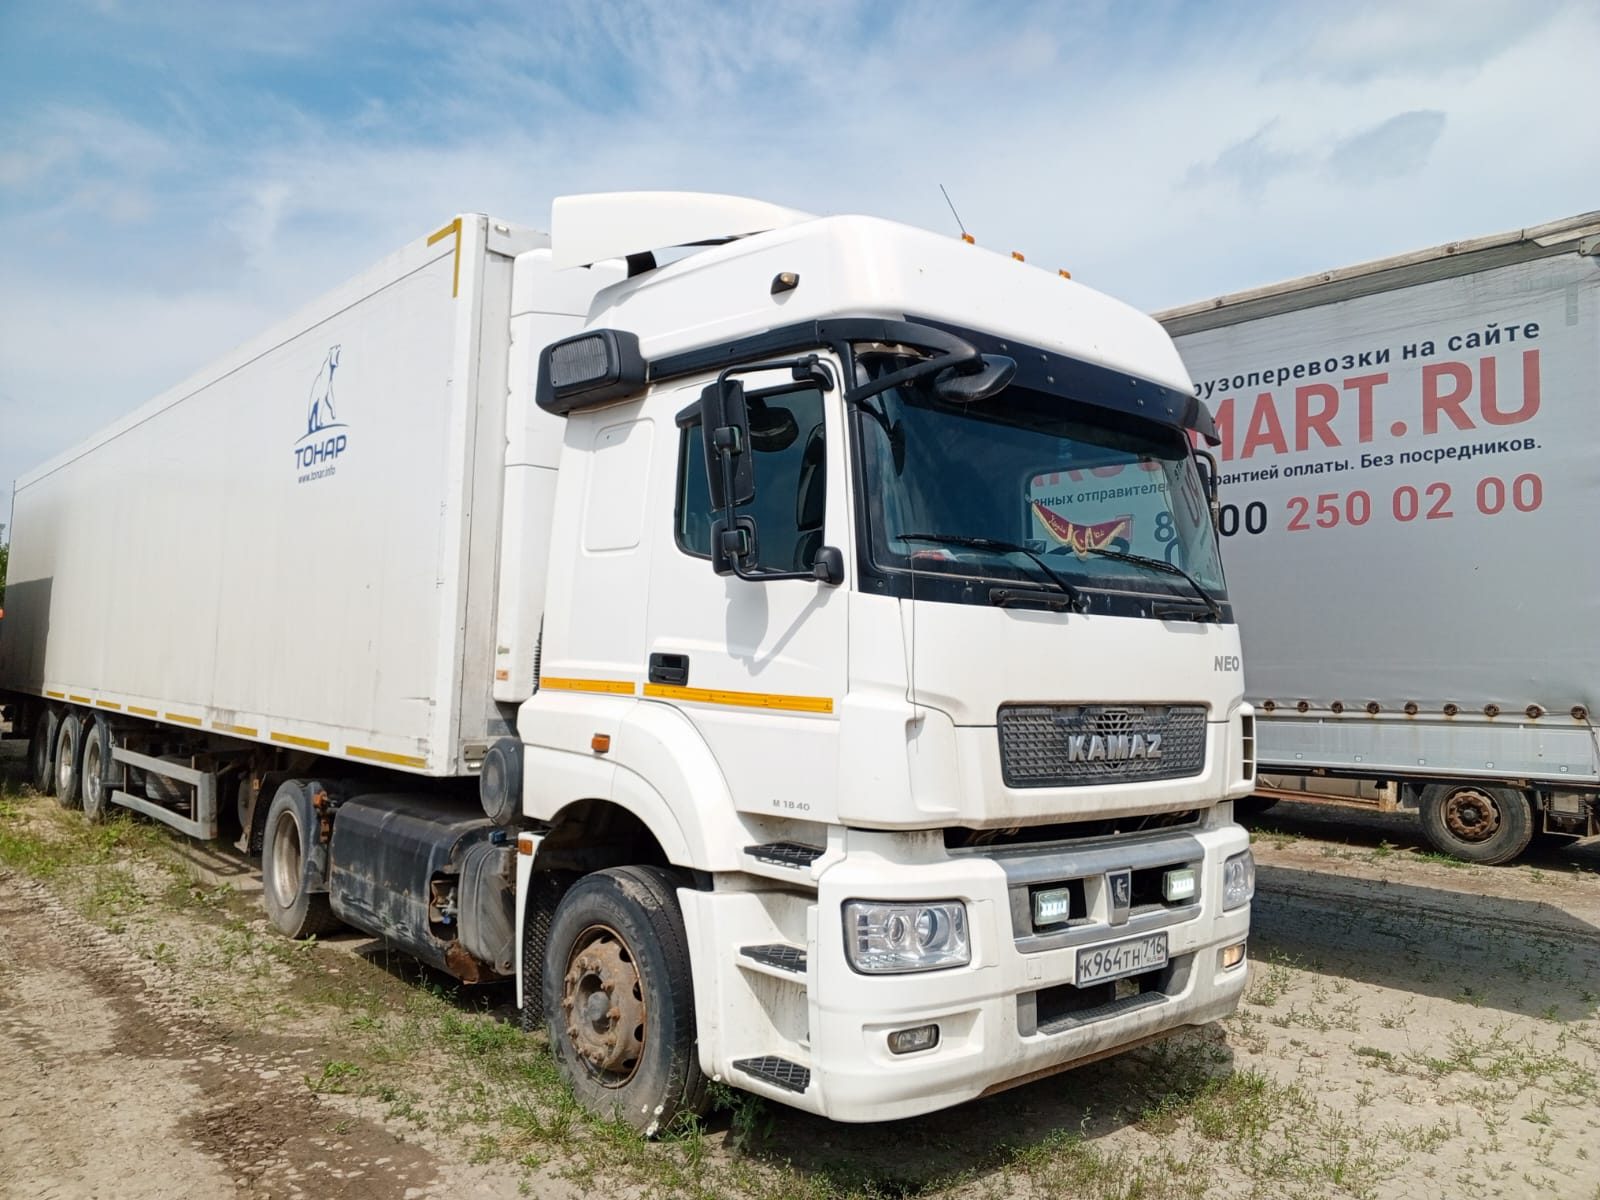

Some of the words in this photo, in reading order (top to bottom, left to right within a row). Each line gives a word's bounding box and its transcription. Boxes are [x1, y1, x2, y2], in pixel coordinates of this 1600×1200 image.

[1402, 340, 1435, 360] на
[1447, 322, 1540, 352] сайте
[1077, 482, 1168, 504] отправителе
[1283, 459, 1355, 478] оплаты.
[1361, 453, 1394, 468] Без
[1400, 438, 1543, 464] посредников.
[1286, 489, 1372, 532] 250
[1392, 481, 1454, 523] 02
[1476, 473, 1543, 516] 00
[1214, 655, 1240, 672] NEO
[1067, 733, 1163, 763] KAMAZ
